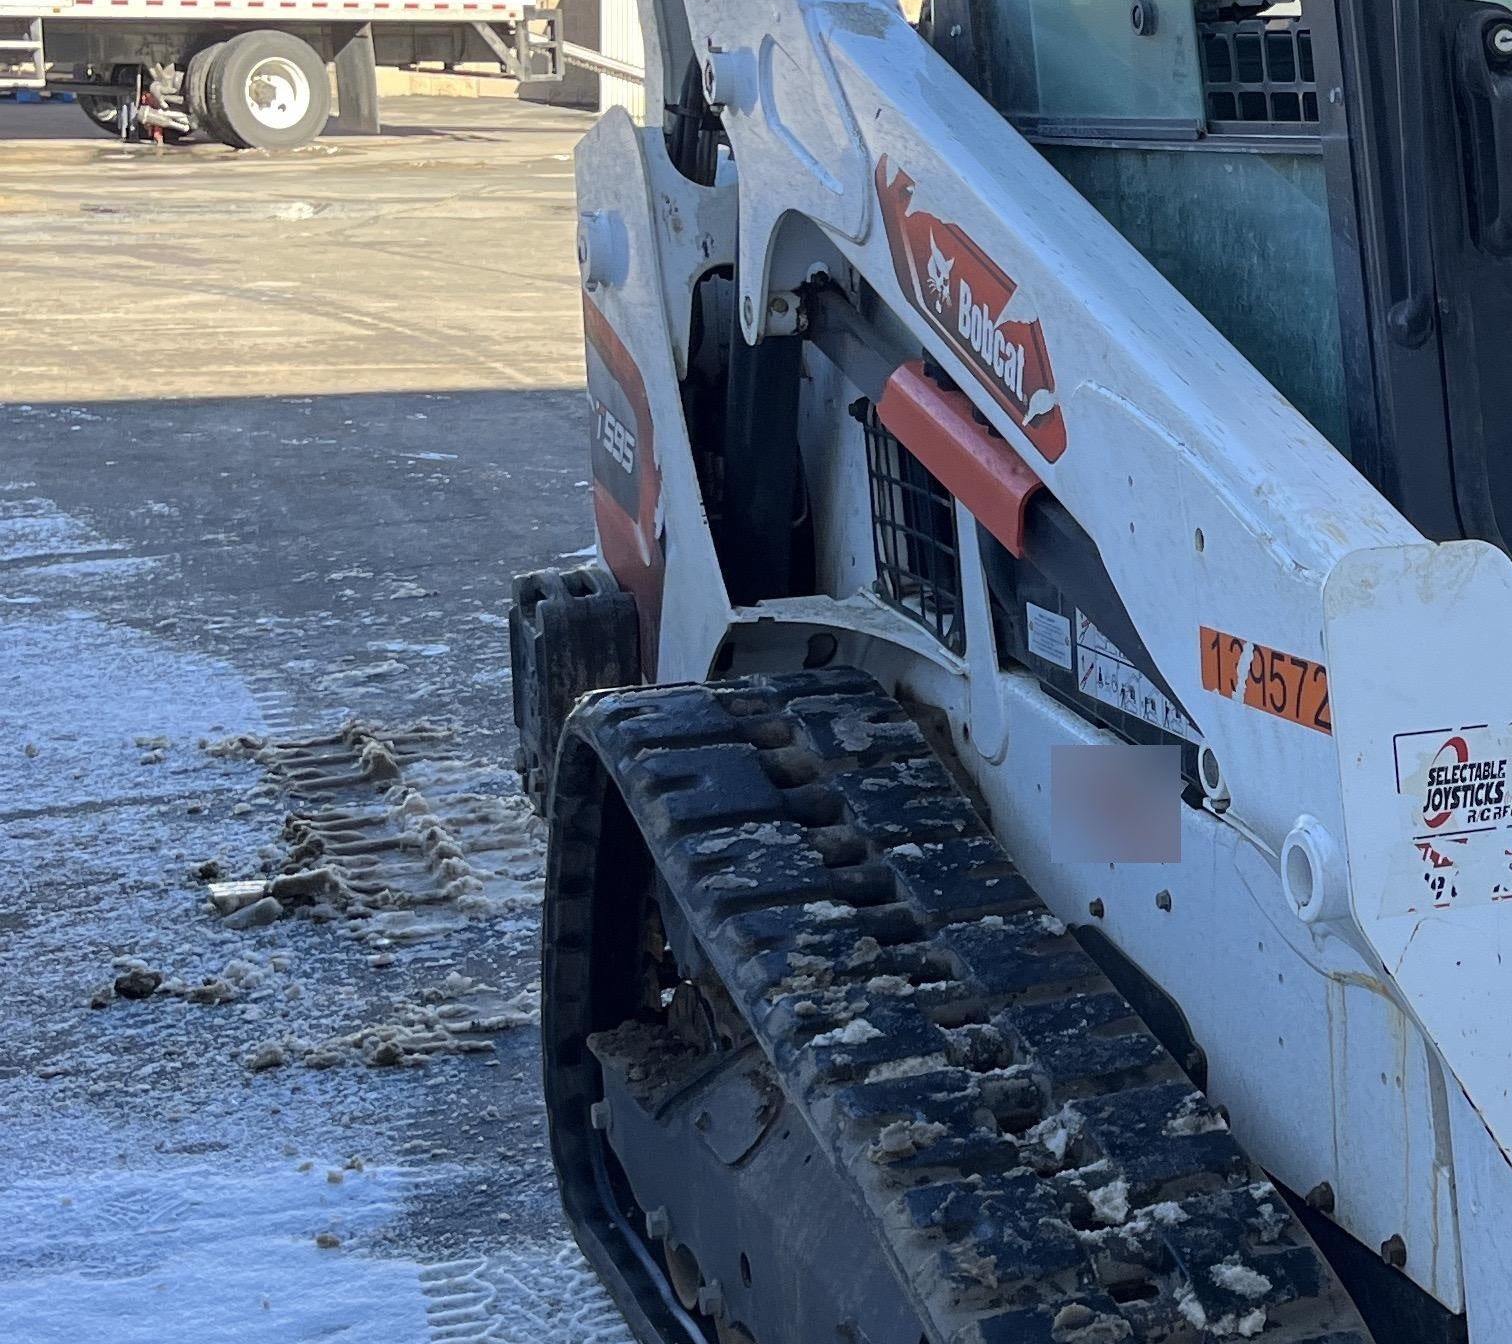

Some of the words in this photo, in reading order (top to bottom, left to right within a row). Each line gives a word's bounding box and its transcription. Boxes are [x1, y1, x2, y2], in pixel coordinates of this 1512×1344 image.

[958, 278, 1025, 402] Bobcat
[1427, 759, 1508, 787] SELECTABLE
[1422, 780, 1505, 813] JOYSTICKS
